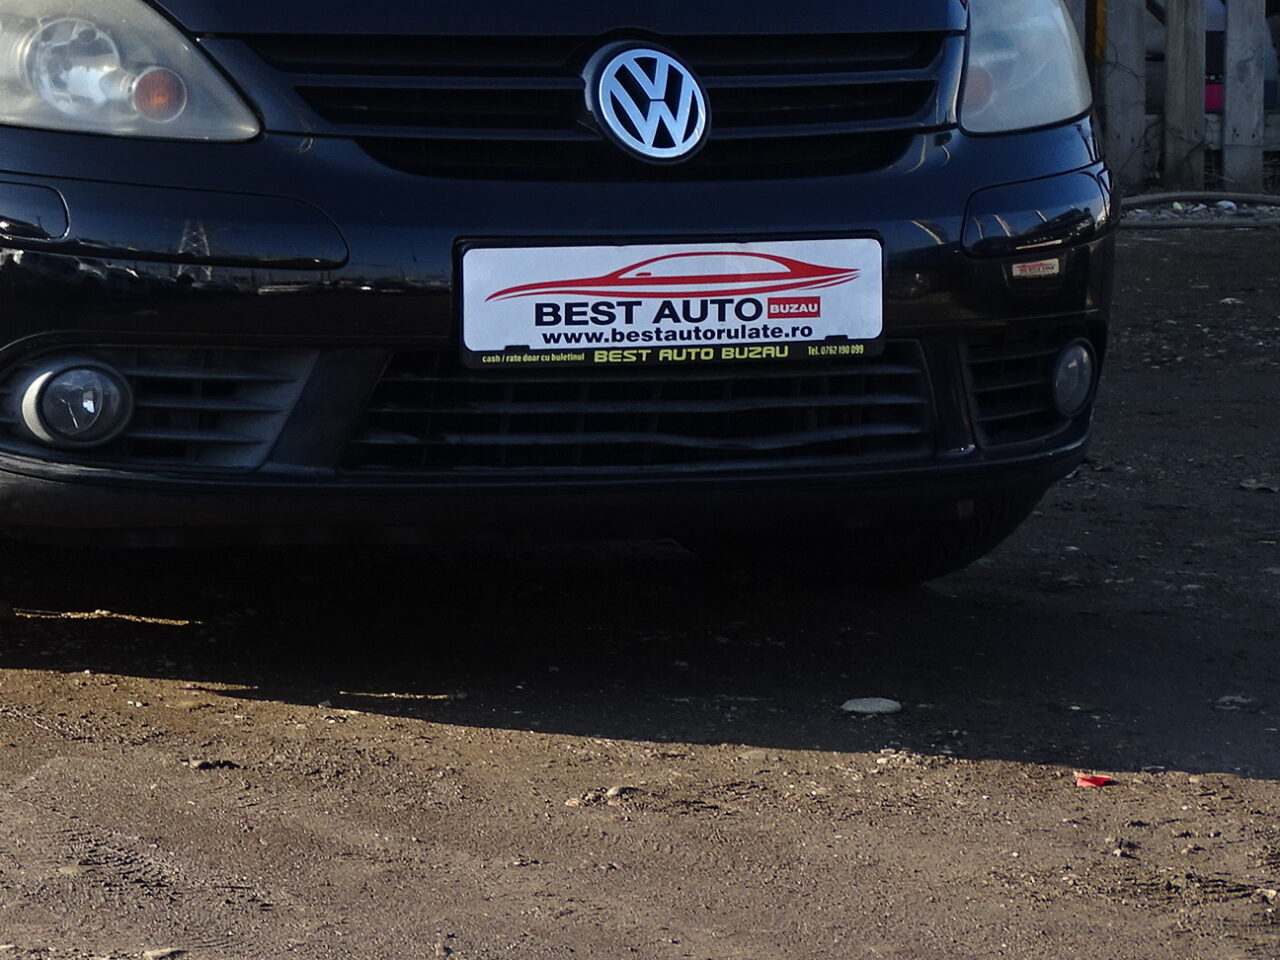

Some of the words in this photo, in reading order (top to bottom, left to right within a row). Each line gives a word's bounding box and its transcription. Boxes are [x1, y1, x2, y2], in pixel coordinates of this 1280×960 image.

[534, 300, 642, 327] BEST
[651, 298, 764, 325] AUTO
[770, 302, 819, 315] BUZAU
[541, 324, 813, 345] www.bestautorulate.ro
[593, 349, 652, 363] BEST
[658, 347, 714, 362] AUTO
[721, 345, 789, 359] BUZAU
